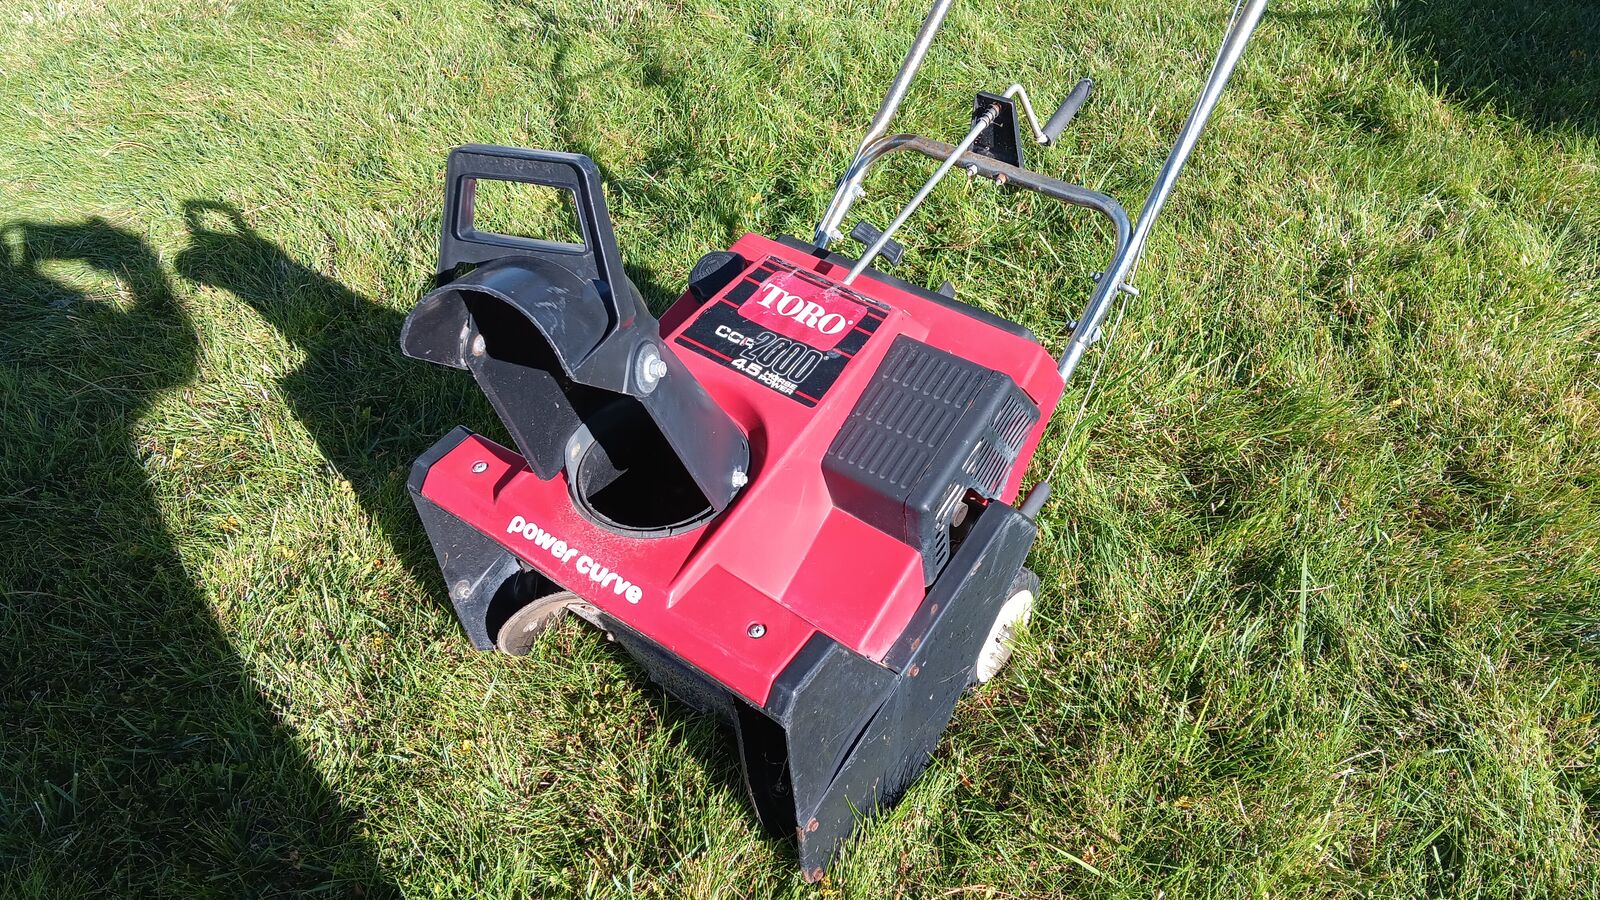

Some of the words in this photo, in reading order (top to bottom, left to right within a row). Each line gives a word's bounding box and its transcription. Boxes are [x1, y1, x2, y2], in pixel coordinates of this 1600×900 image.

[757, 283, 846, 335] TORO
[715, 325, 754, 349] CCR
[740, 331, 823, 384] 2000
[731, 358, 763, 376] 4.5
[758, 374, 794, 395] POWER
[764, 370, 798, 390] HORSE
[506, 515, 578, 563] power
[576, 555, 643, 604] curve
